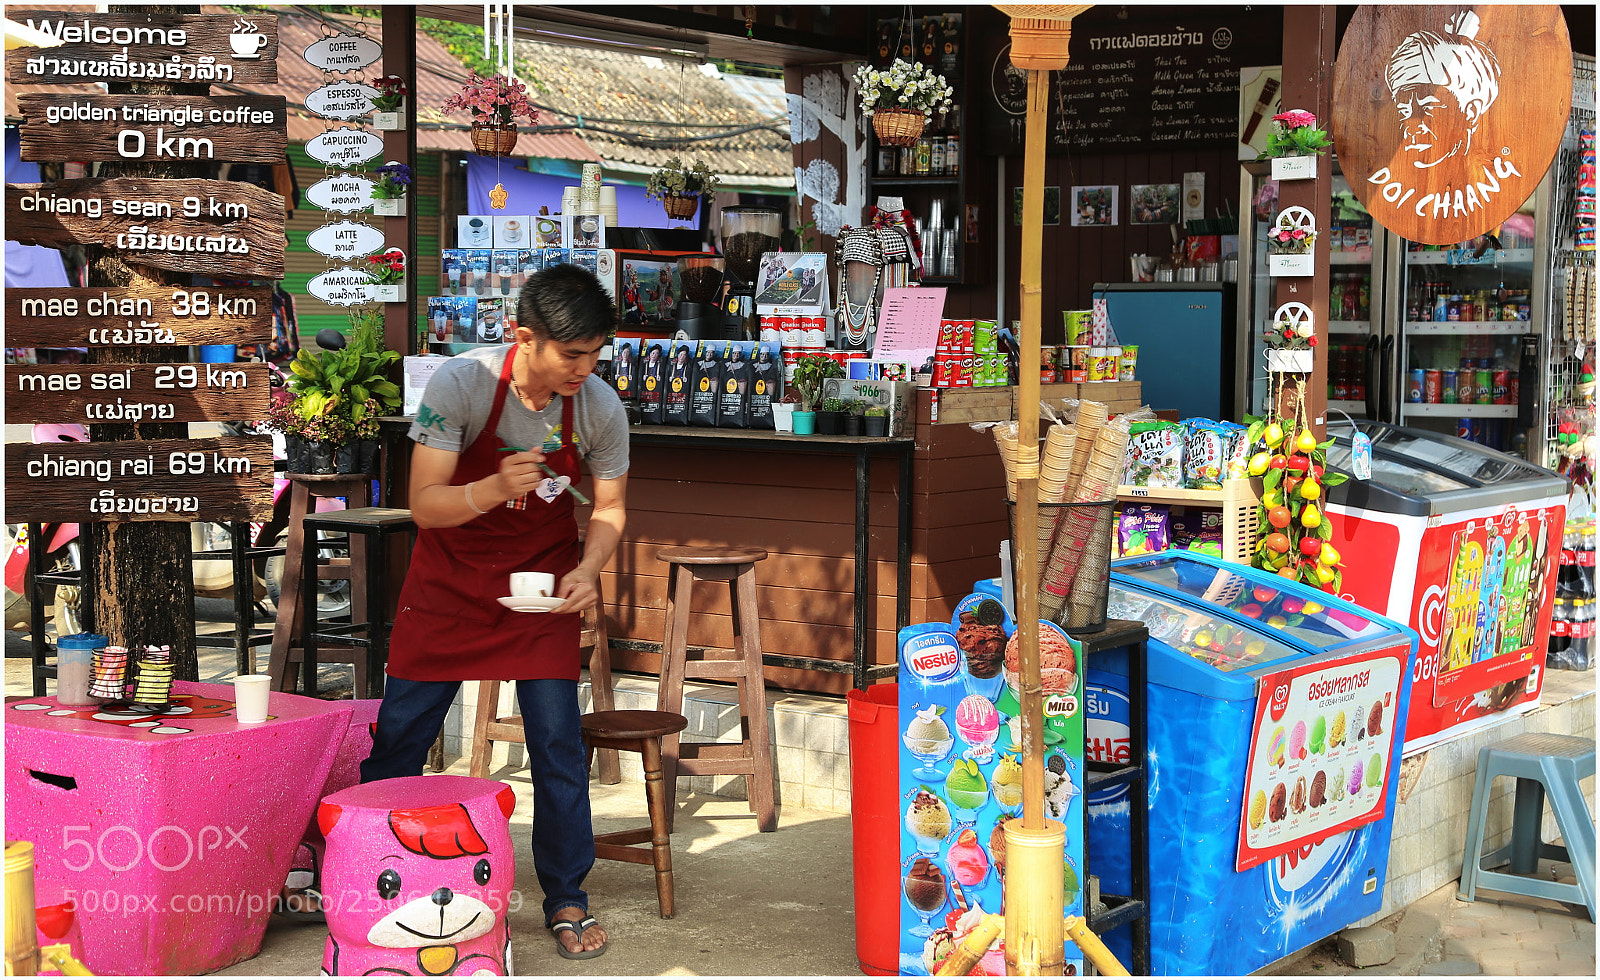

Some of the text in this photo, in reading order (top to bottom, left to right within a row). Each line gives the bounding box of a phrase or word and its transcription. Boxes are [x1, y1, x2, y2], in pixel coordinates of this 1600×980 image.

[26, 19, 187, 46] Welcome
[1089, 26, 1204, 51] กาแฟดอยช้าง
[329, 42, 357, 51] COFFEE
[26, 47, 233, 81] สามเหลี่ยมรำลึก
[326, 54, 360, 65] กาแฟสด
[327, 88, 361, 98] ESPESSO
[46, 101, 274, 127] golden triangle coffee
[117, 129, 214, 159] 0 km
[322, 135, 368, 146] CAPUCCINO
[331, 182, 360, 192] MOCHA
[1368, 156, 1521, 219] DOI CHAANG
[20, 192, 248, 218] chiang sean 9 km
[117, 226, 249, 254] เจียงแสน
[335, 230, 357, 239] LATTE
[21, 291, 257, 317] mae chan 38 km
[89, 321, 176, 344] แม่จัน
[18, 363, 247, 391] mae sai 29 km
[859, 384, 880, 397] 1966
[85, 397, 175, 421] แม่สาย
[27, 451, 252, 481] chiang rai 69 km
[89, 489, 199, 513] เจียงฮาย
[915, 635, 945, 648] ไอศกรีม
[1308, 669, 1371, 701] อร่อยหลากรส
[1047, 701, 1075, 712] MILO
